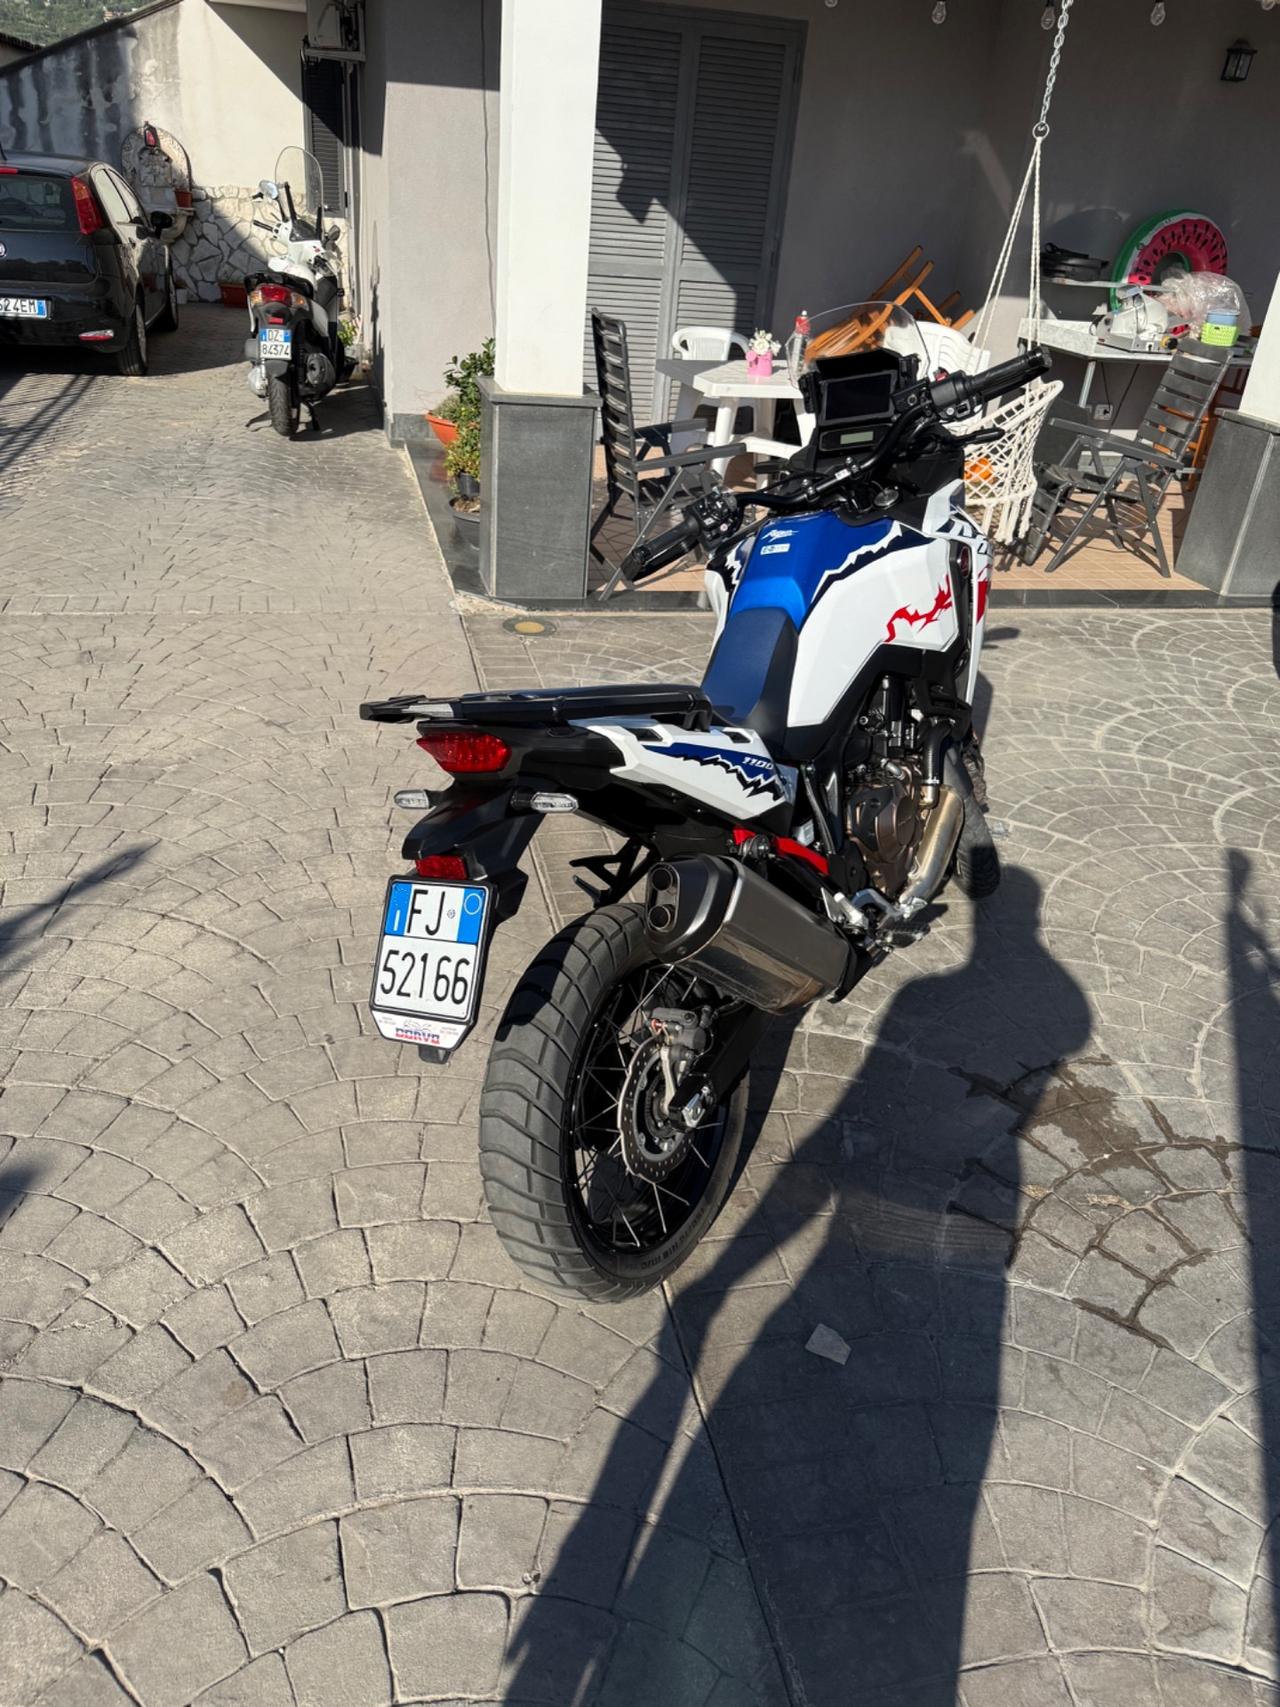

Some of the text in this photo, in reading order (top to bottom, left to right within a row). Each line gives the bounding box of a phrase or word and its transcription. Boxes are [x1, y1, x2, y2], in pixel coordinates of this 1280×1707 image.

[268, 330, 280, 342] DZ
[262, 343, 289, 356] 84374
[741, 756, 774, 770] 1100
[406, 888, 446, 936] FJ
[380, 949, 470, 1005] 52166
